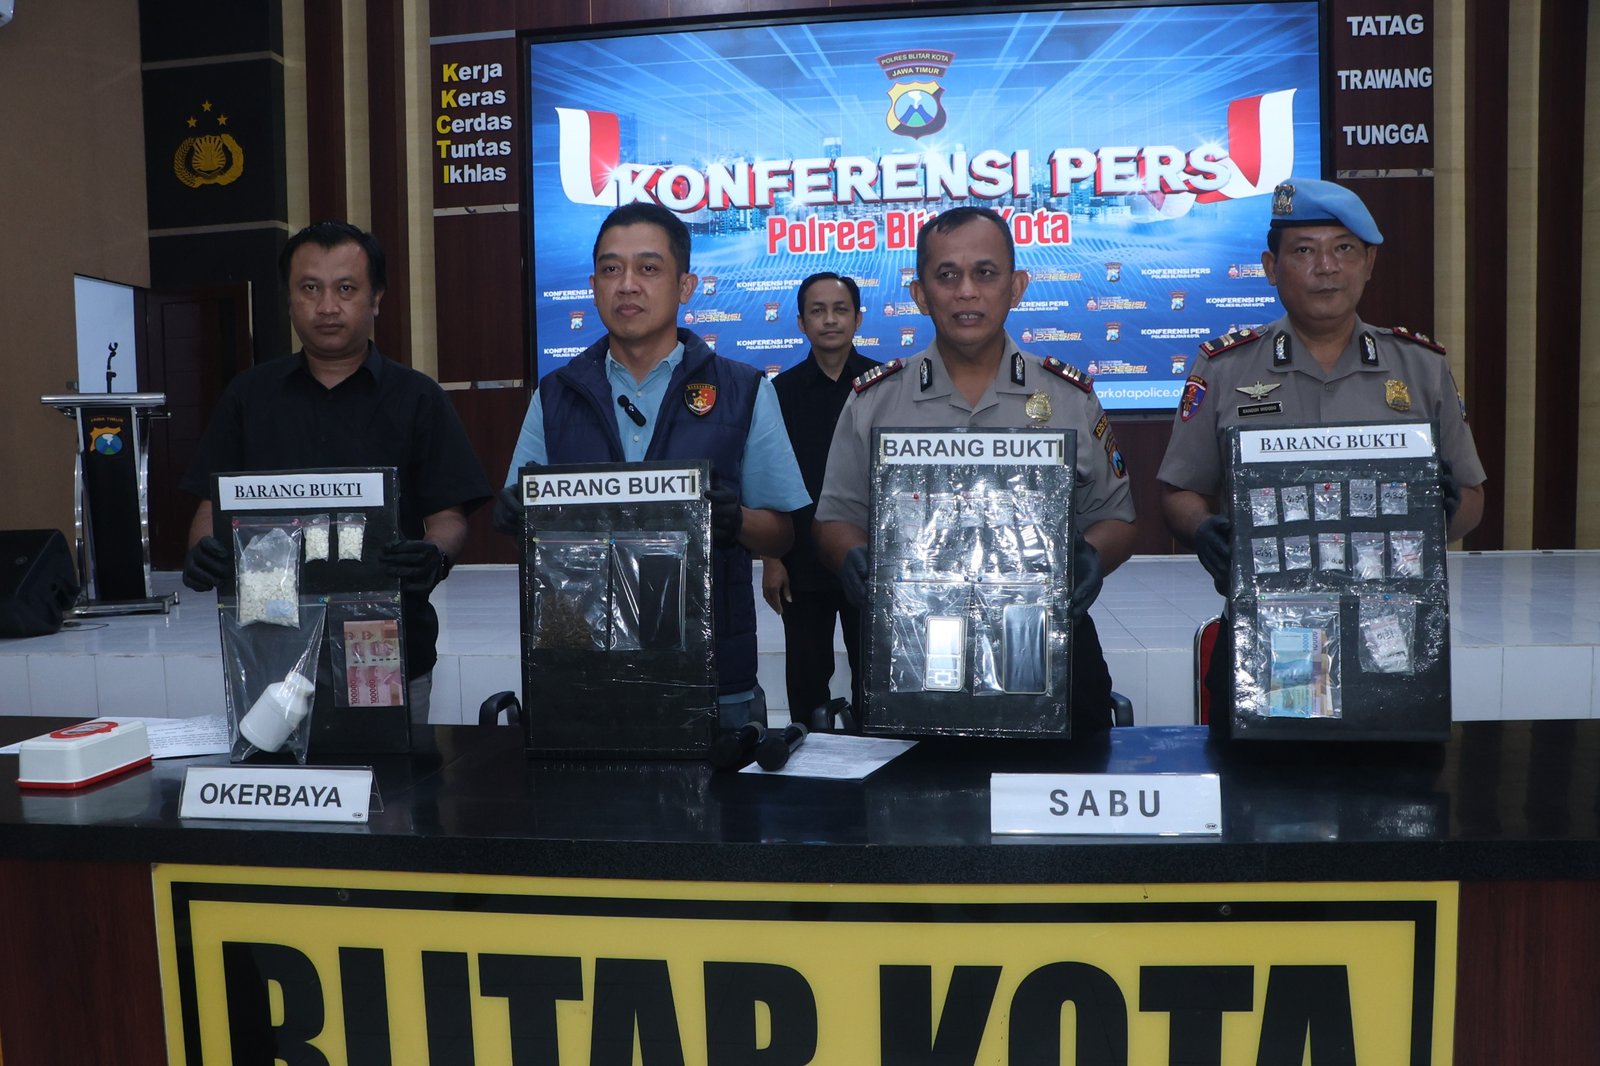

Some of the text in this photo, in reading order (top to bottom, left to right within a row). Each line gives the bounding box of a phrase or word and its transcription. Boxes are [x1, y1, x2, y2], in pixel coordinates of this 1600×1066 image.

[1347, 13, 1424, 36] TATAG
[881, 54, 907, 65] POLRES
[931, 53, 949, 62] KOTA
[443, 63, 503, 83] Kerja
[892, 66, 940, 77] JAWA TIMUR
[1337, 66, 1433, 90] TRAWANG
[441, 89, 507, 108] Keras
[436, 112, 512, 134] Cerdas
[1343, 123, 1429, 145] TUNGGA
[436, 138, 512, 158] Tuntas
[443, 163, 507, 184] Ikhlas
[614, 145, 1232, 212] KONFERENSI PERS
[769, 213, 876, 254] Polres
[1141, 267, 1211, 276] KONFERENSI PERS
[883, 438, 1064, 458] BARANG BUKTI
[1260, 432, 1408, 451] BARANG BUKTI
[234, 482, 362, 498] BARANG BUKTI
[526, 474, 696, 499] BARANG BUKTI
[199, 782, 342, 808] OKERBAYA
[1049, 789, 1161, 818] SABU
